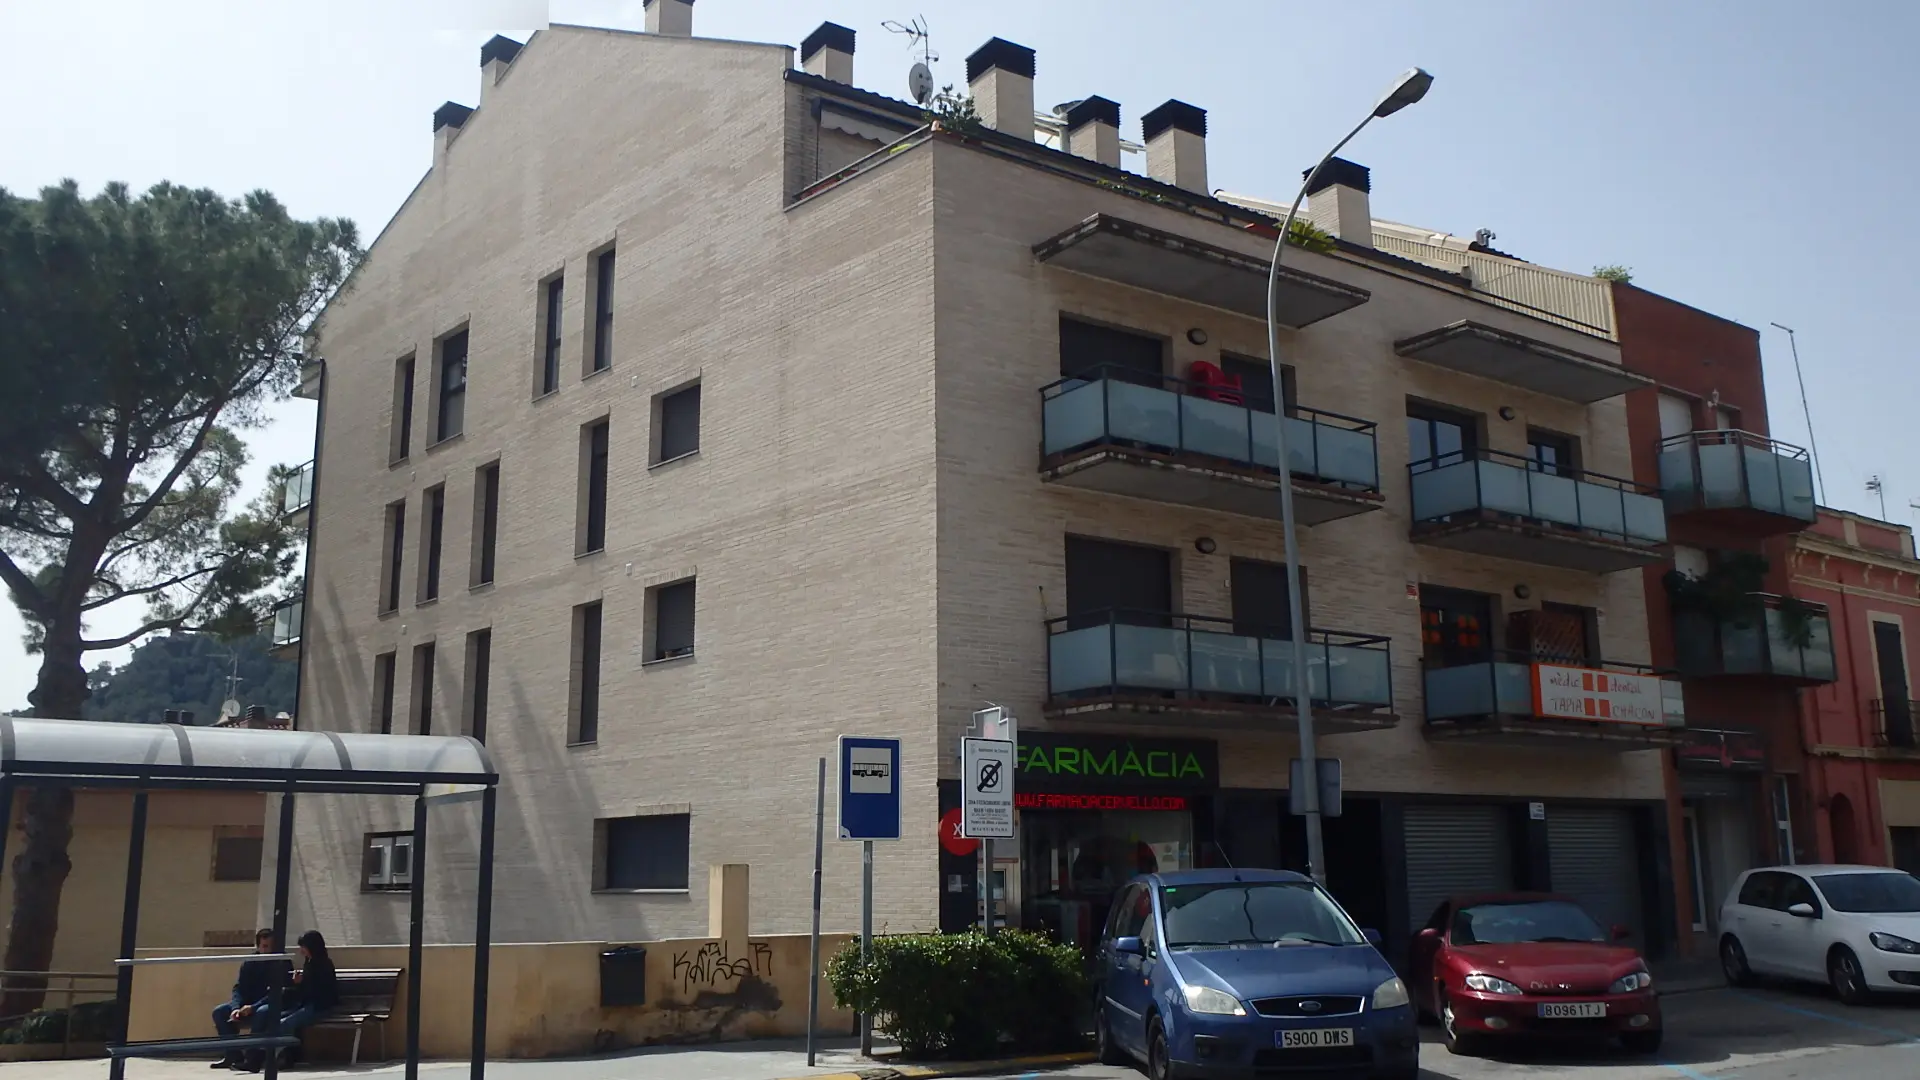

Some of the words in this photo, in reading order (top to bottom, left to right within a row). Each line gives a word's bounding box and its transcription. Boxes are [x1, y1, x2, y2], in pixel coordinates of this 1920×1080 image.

[1610, 677, 1642, 694] dental
[1017, 742, 1204, 779] FARMÀCIA
[1284, 1031, 1318, 1046] 5900
[1323, 1030, 1349, 1045] DWS
